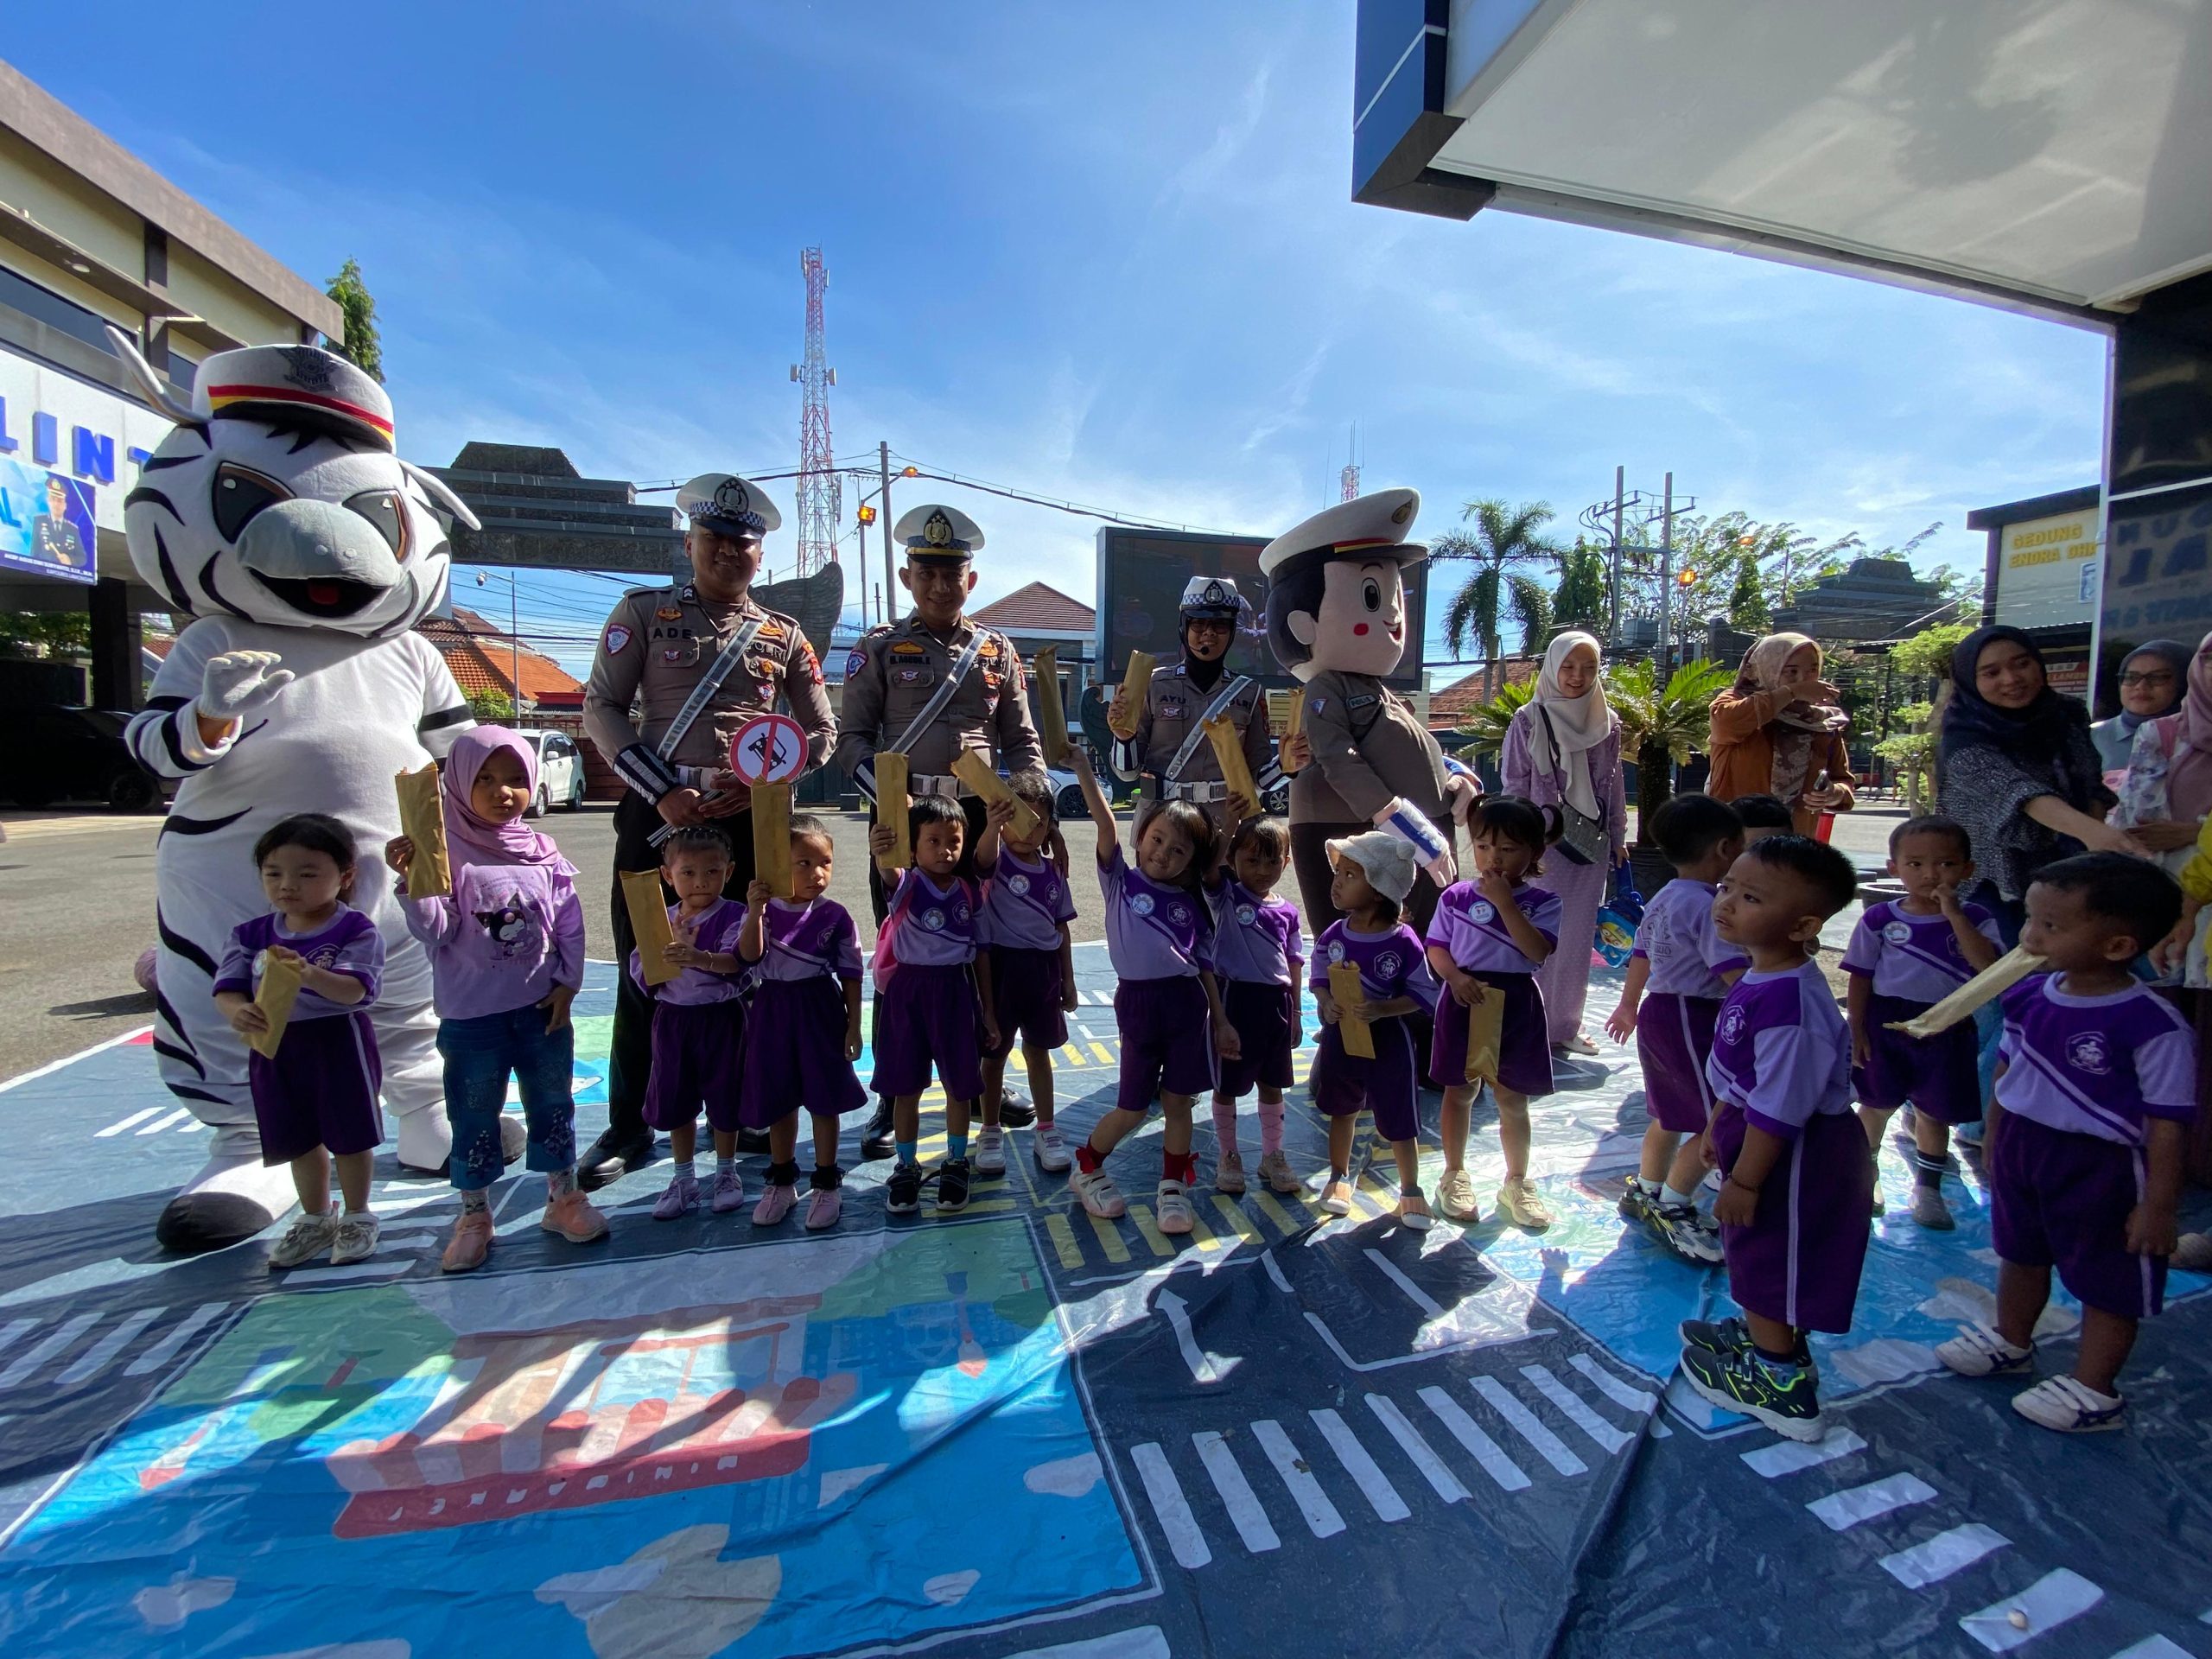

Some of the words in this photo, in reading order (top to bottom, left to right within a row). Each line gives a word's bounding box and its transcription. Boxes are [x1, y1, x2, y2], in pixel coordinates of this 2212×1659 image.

[2012, 524, 2082, 549] GEDUNG
[2009, 547, 2061, 568] ENDRA
[653, 627, 692, 639] ADE
[1160, 695, 1186, 704] AYU
